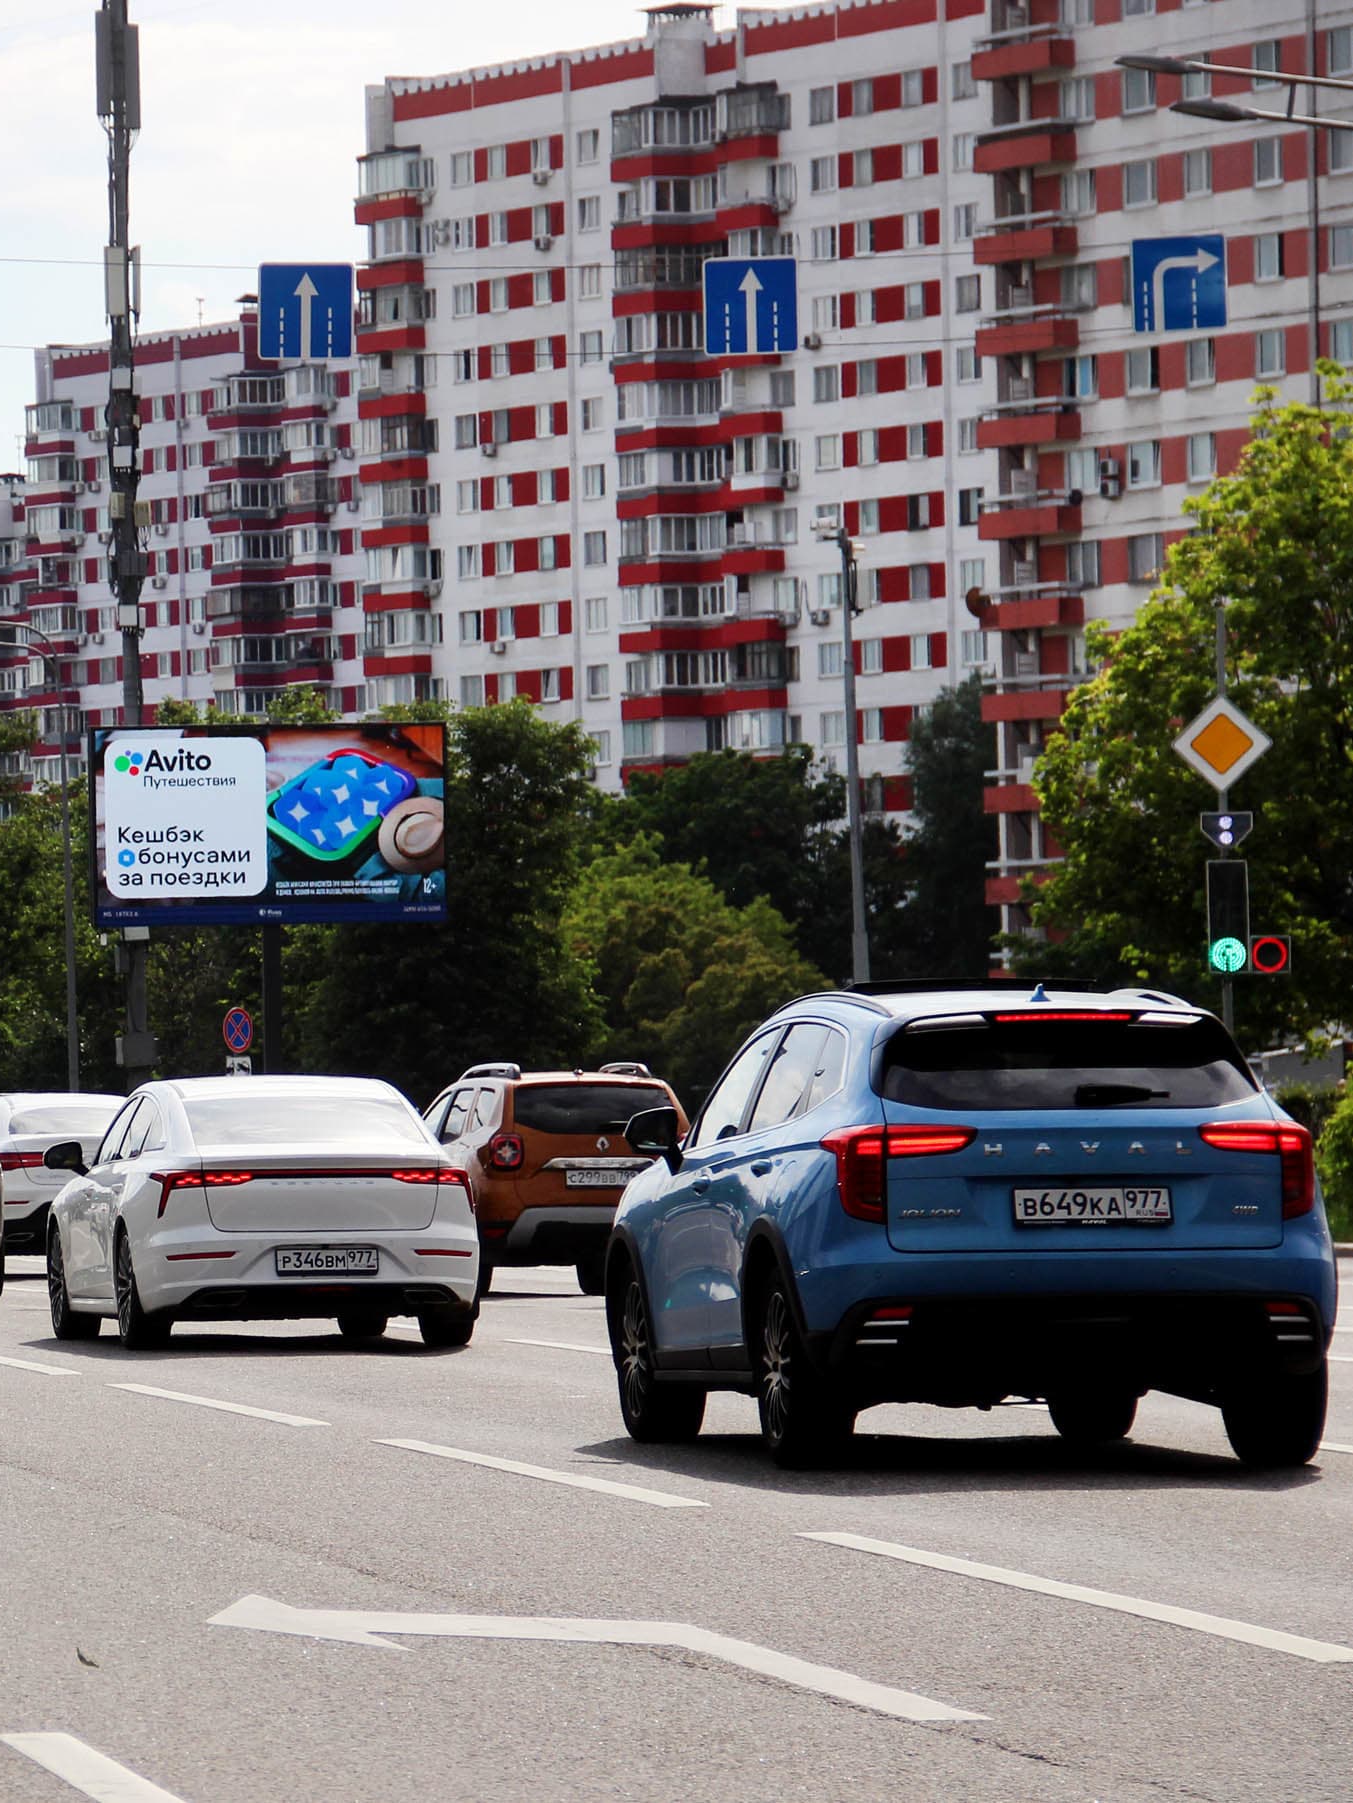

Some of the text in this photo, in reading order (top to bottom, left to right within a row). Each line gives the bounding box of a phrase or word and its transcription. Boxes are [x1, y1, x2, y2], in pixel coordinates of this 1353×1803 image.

[144, 749, 212, 772] Avito
[144, 775, 236, 789] Путешествия
[118, 826, 204, 843] Кешбэк
[138, 848, 251, 868] бонусами
[119, 872, 246, 887] за поездки
[423, 878, 437, 893] 12+
[984, 1141, 1192, 1157] HAVAL
[1125, 1190, 1162, 1209] 977
